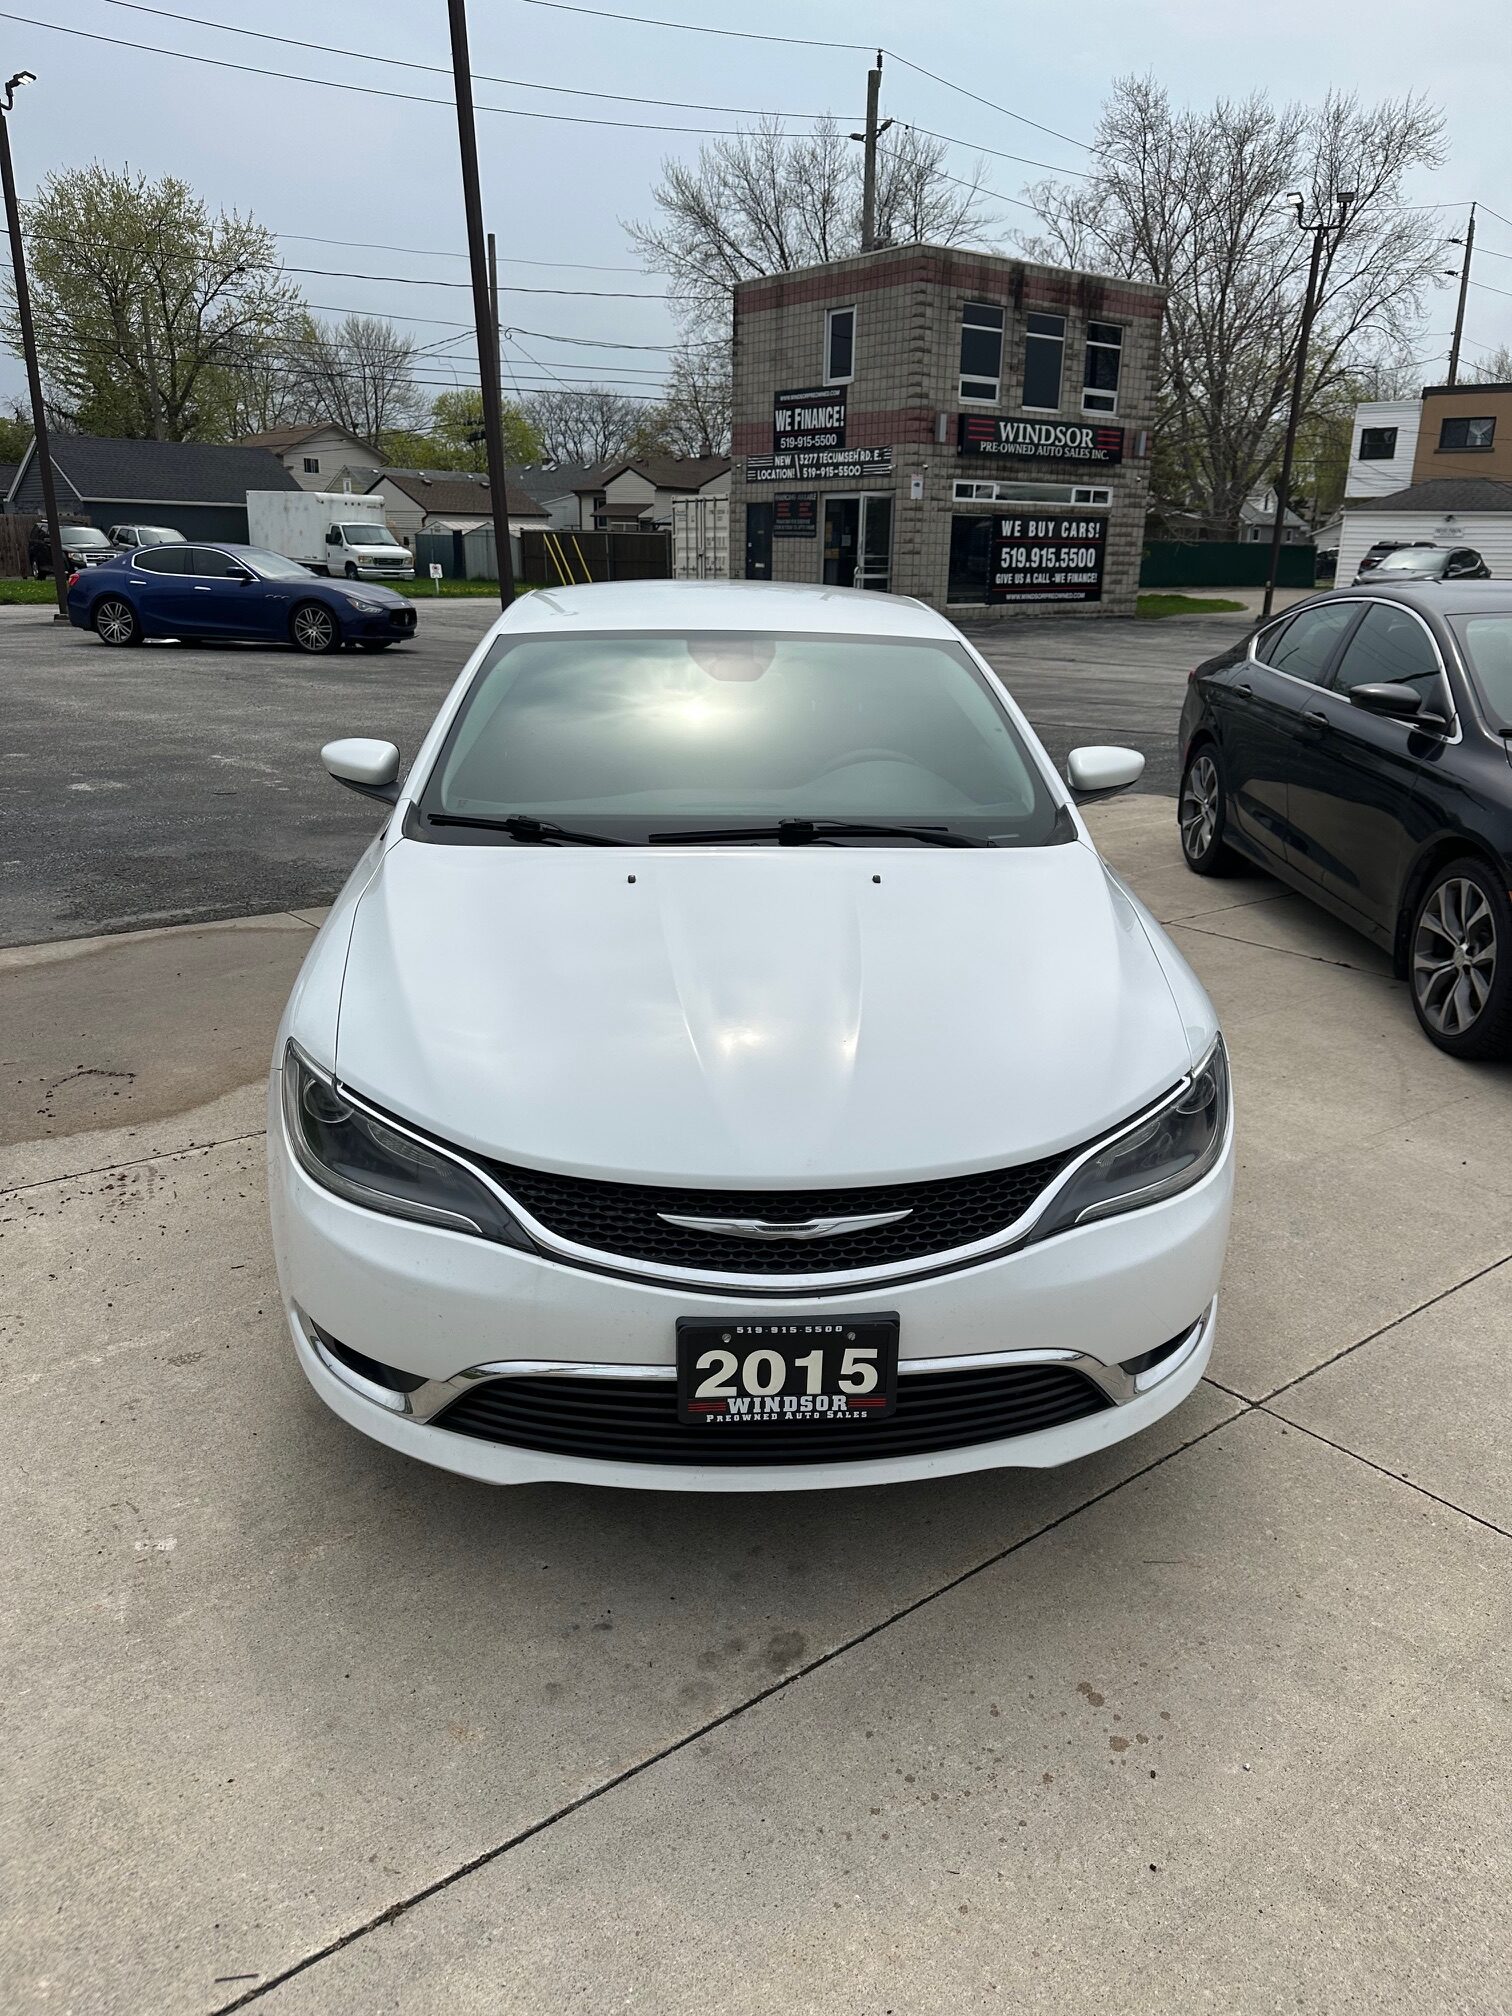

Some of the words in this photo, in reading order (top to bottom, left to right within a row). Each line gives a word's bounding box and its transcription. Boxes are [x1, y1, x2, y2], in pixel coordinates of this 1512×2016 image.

[775, 409, 792, 432] WE
[794, 405, 845, 430] FINANCE!
[780, 433, 837, 448] 519-915-5500
[999, 421, 1094, 448] WINDSOR
[799, 453, 818, 465] 3277
[819, 450, 858, 464] TECUMSEH
[859, 450, 872, 462] RD.
[873, 450, 882, 461] E.
[979, 441, 1035, 455] PRE-OWNED
[1036, 445, 1063, 457] AUTO
[1064, 447, 1090, 459] SALES
[1091, 449, 1110, 460] INC.
[774, 454, 792, 466] NEW
[757, 467, 796, 480] LOCATION!
[802, 465, 861, 478] 519-915-5500
[1001, 520, 1022, 537] WE
[1028, 521, 1055, 538] BUY
[1061, 521, 1101, 538] CARS!
[1000, 547, 1096, 568] 519.915.5500
[995, 573, 1013, 584] GIVE
[1014, 573, 1024, 584] US
[1025, 573, 1031, 584] A
[1033, 573, 1050, 583] CALL
[1067, 572, 1098, 583] FINANCE!
[736, 1325, 843, 1334] 519-915-5500
[694, 1348, 879, 1398] 2015
[727, 1395, 848, 1414] WINDSOR
[706, 1413, 778, 1423] PREOWNED
[784, 1411, 820, 1420] AUTO
[826, 1410, 868, 1418] SALES
